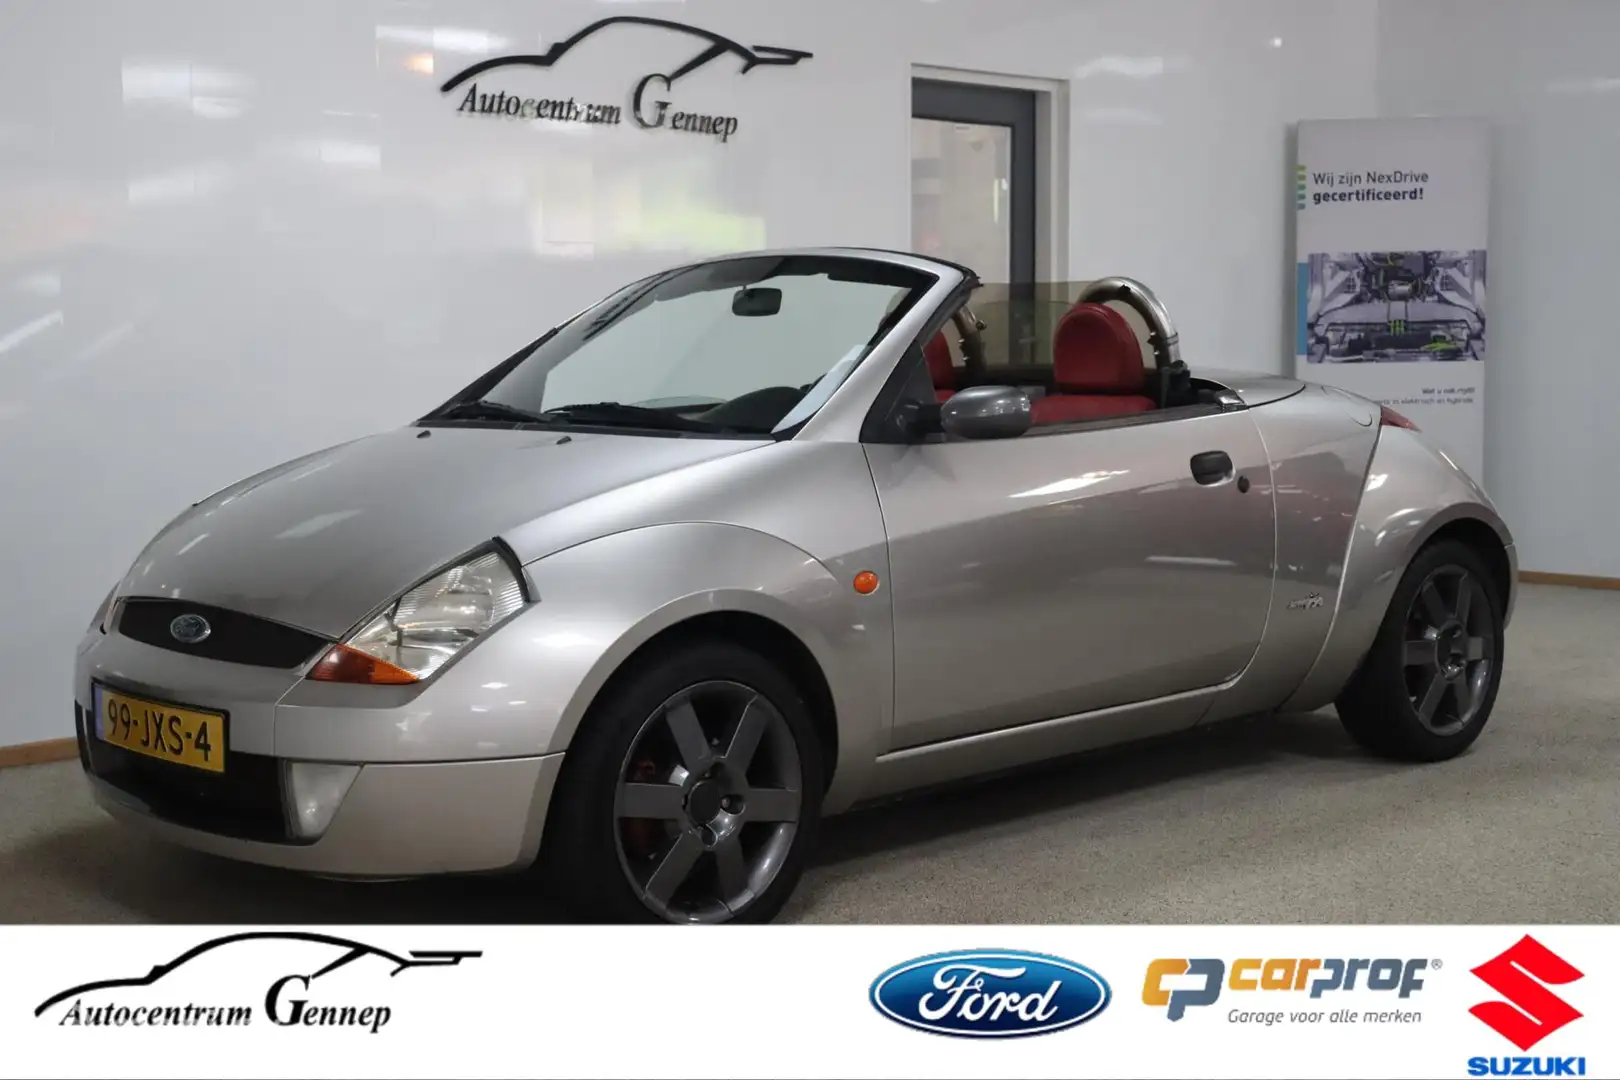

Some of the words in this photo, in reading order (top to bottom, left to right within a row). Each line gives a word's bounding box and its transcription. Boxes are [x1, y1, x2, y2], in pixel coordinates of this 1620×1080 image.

[456, 83, 622, 126] Autocentrum
[632, 73, 740, 142] Gennep
[1313, 172, 1335, 187] Wij
[1338, 171, 1362, 187] zijn
[1366, 171, 1429, 184] NexDrive
[1313, 187, 1424, 205] gecertificeerd!
[108, 698, 211, 762] 99-JXS-4
